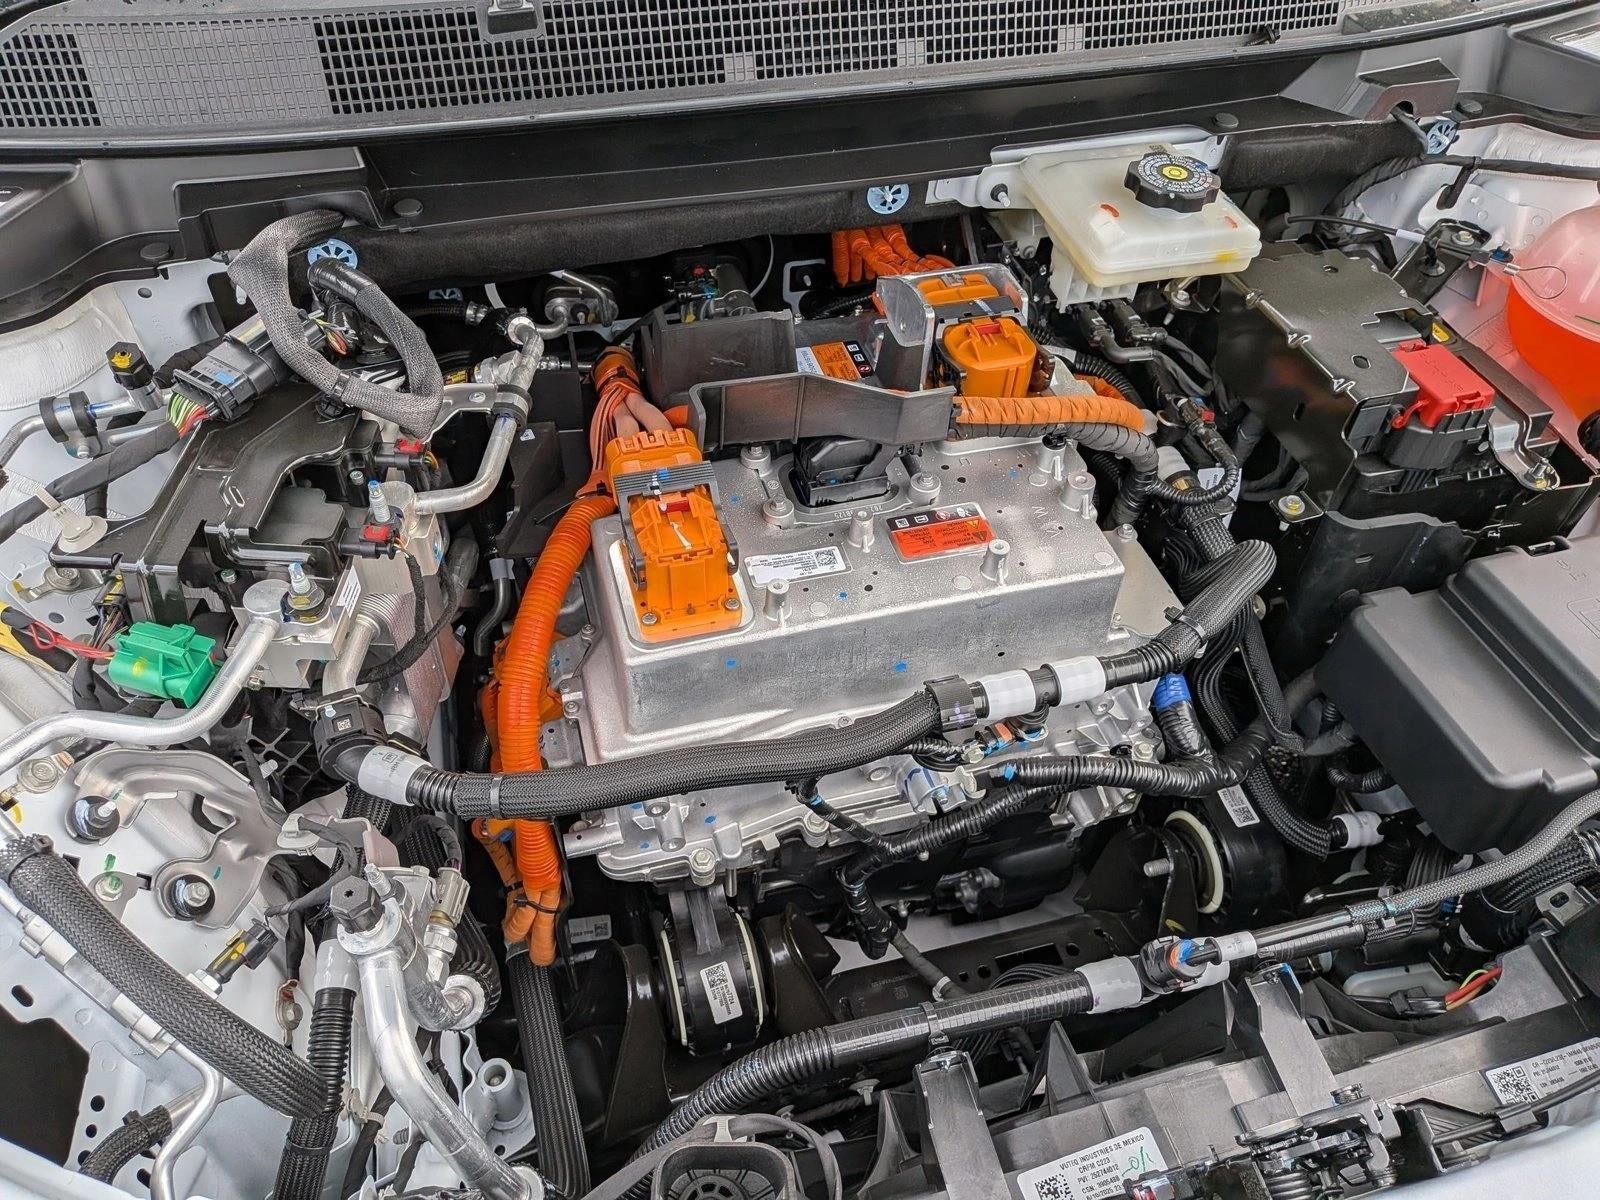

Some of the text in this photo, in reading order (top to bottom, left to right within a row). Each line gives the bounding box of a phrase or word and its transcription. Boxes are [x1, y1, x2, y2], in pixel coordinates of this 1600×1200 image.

[1060, 1134, 1145, 1170] VUTEQ INDUSTRIES DE MEXICO
